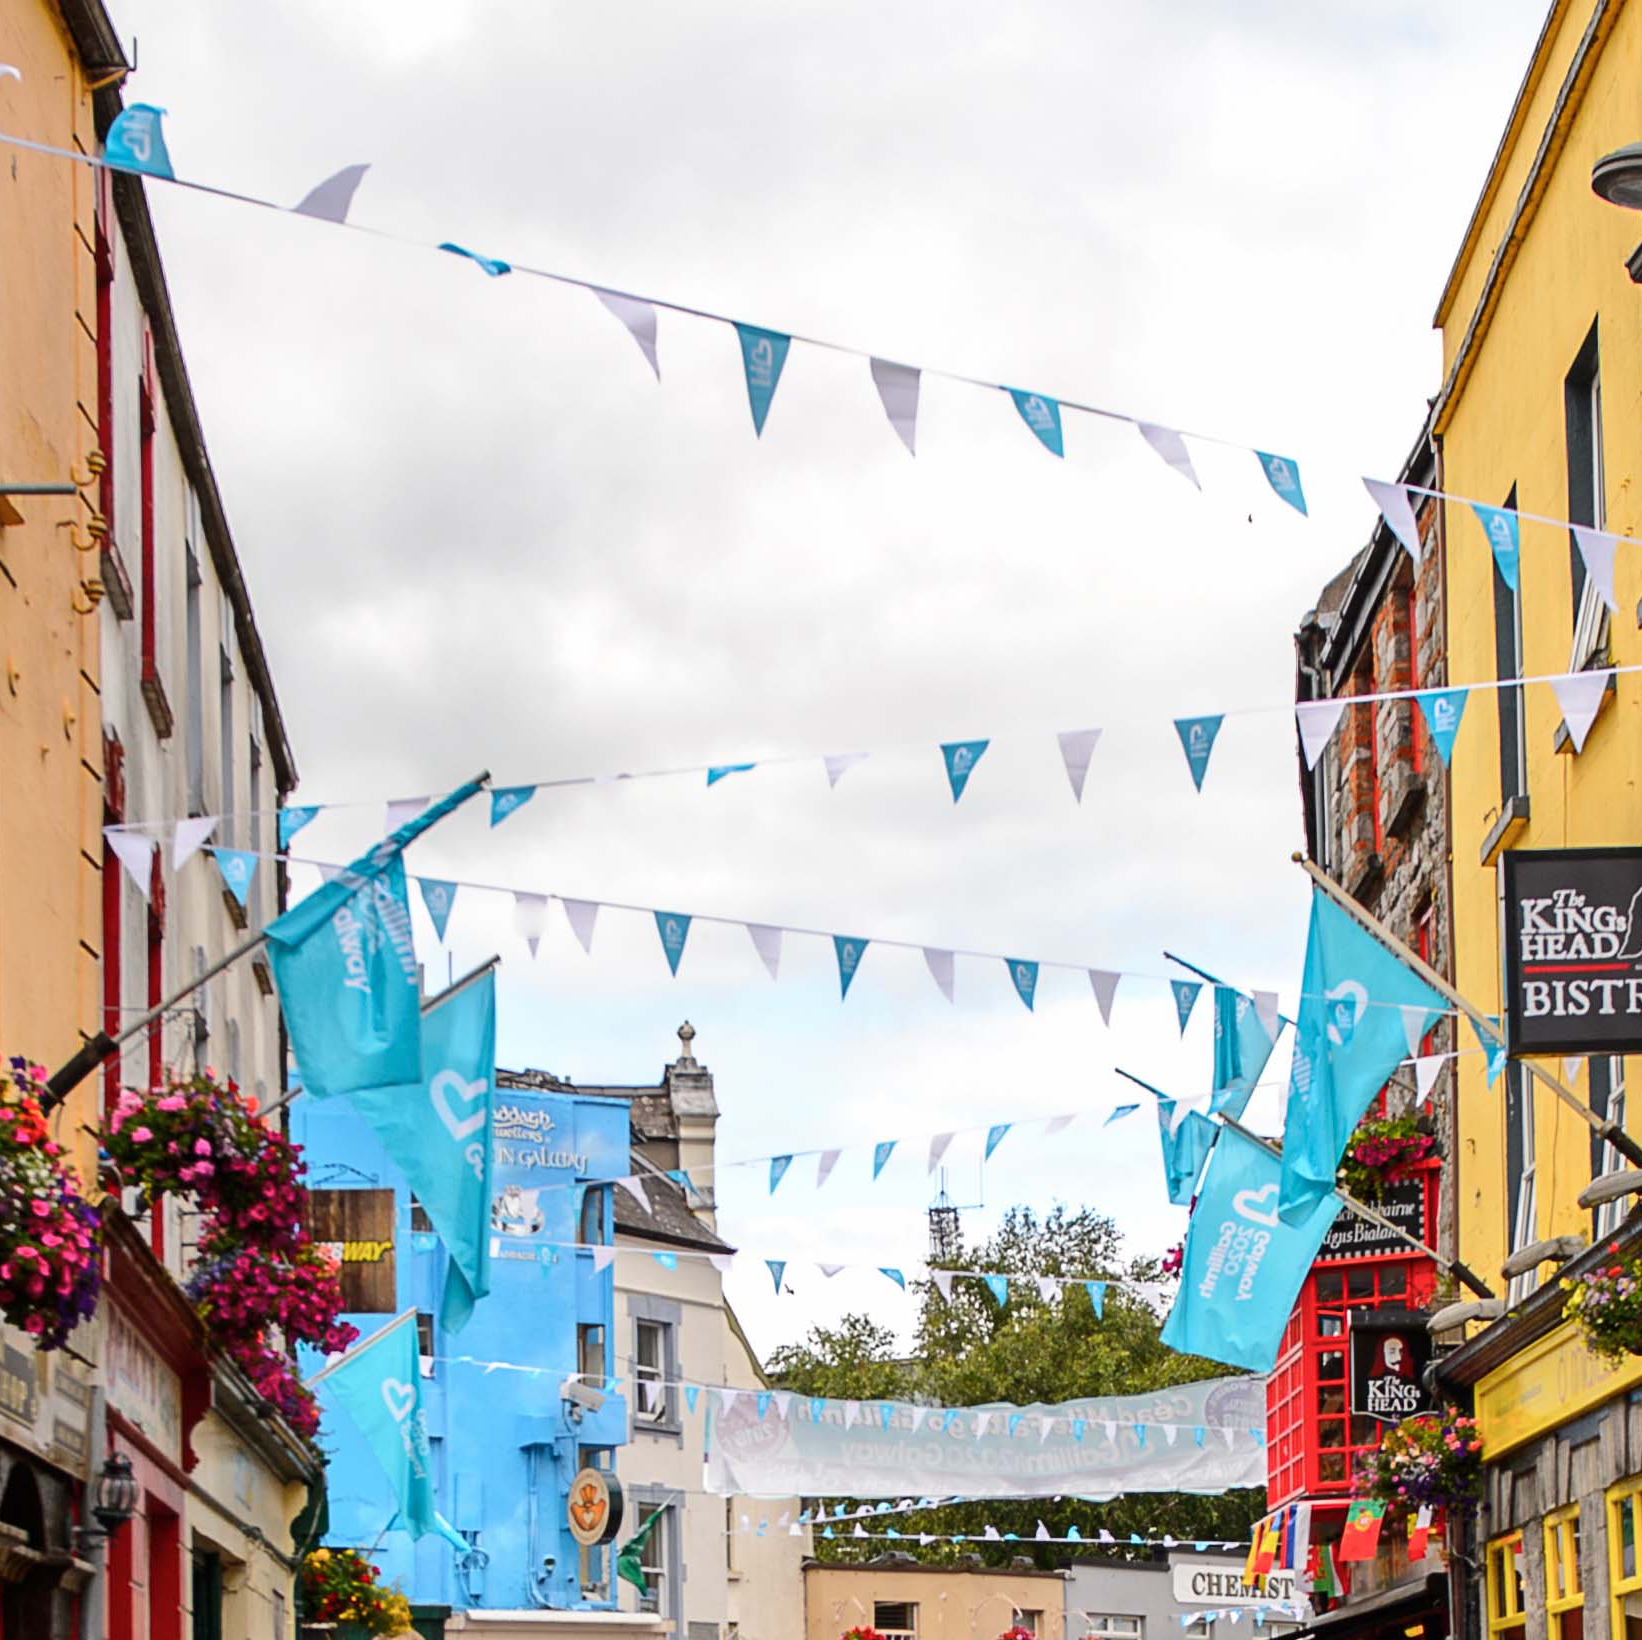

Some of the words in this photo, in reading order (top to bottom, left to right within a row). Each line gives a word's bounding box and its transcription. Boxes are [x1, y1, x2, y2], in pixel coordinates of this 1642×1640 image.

[1553, 889, 1586, 908] The
[331, 898, 371, 993] alway
[1521, 932, 1620, 961] HEAD
[1368, 1398, 1417, 1412] HEAD
